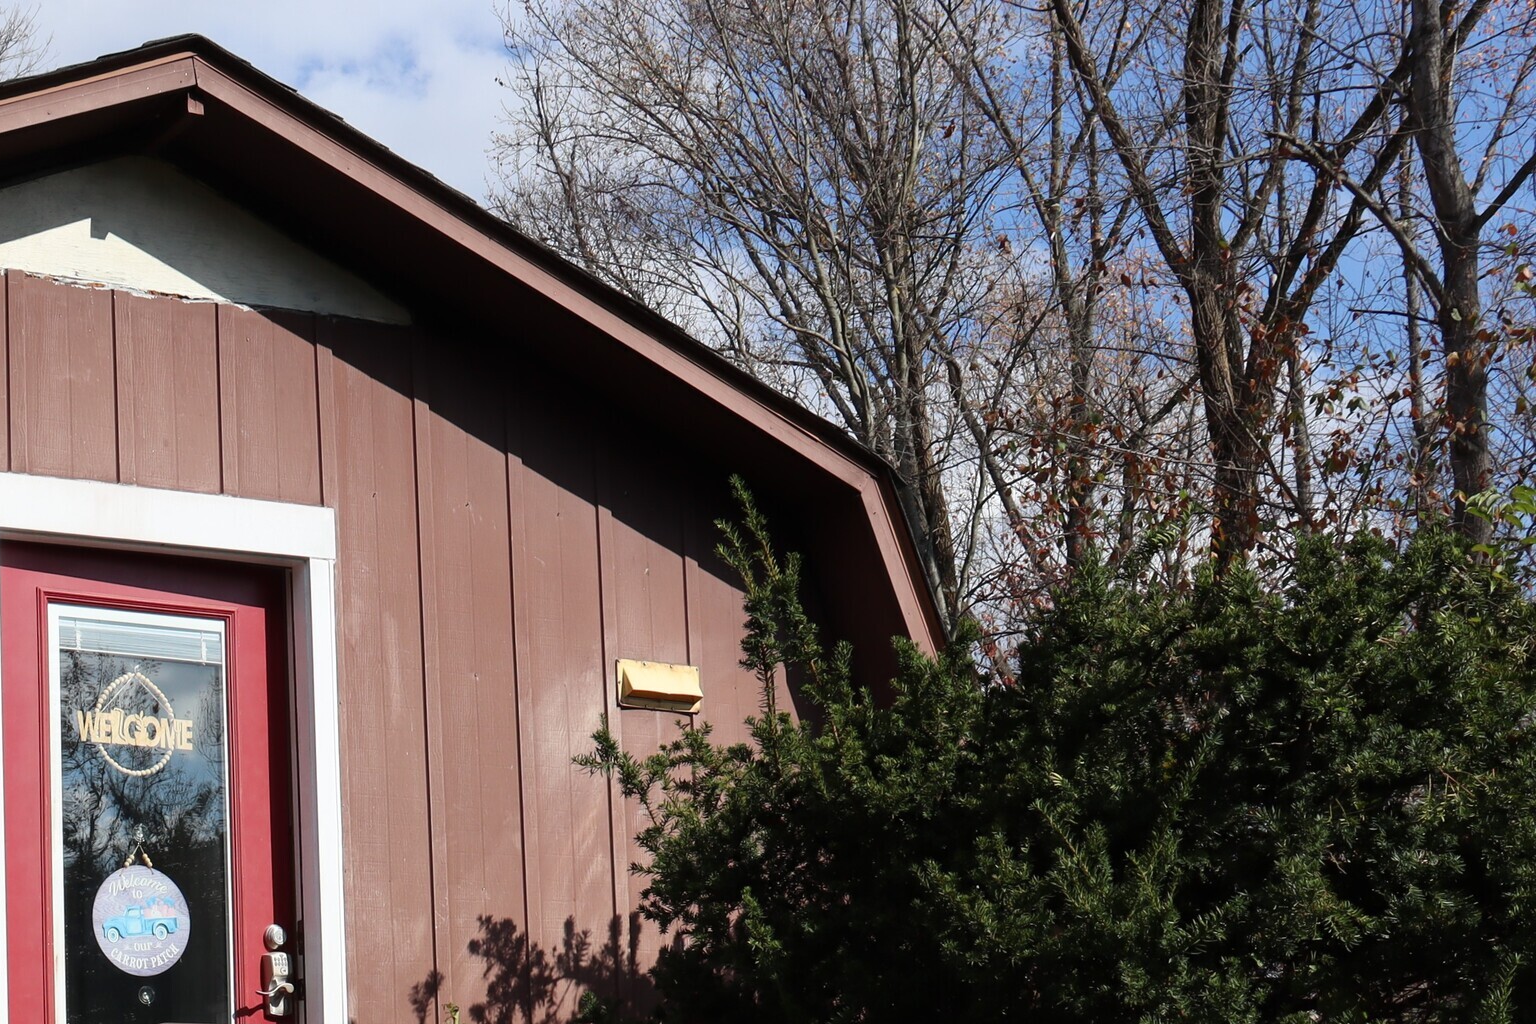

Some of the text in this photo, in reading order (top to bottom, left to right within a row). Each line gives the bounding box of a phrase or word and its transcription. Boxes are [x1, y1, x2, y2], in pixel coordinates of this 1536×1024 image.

[77, 708, 193, 750] WELCOME
[108, 873, 168, 896] Welcome
[132, 888, 143, 899] to
[110, 943, 180, 969] CARROT PATCH
[133, 942, 153, 952] our
